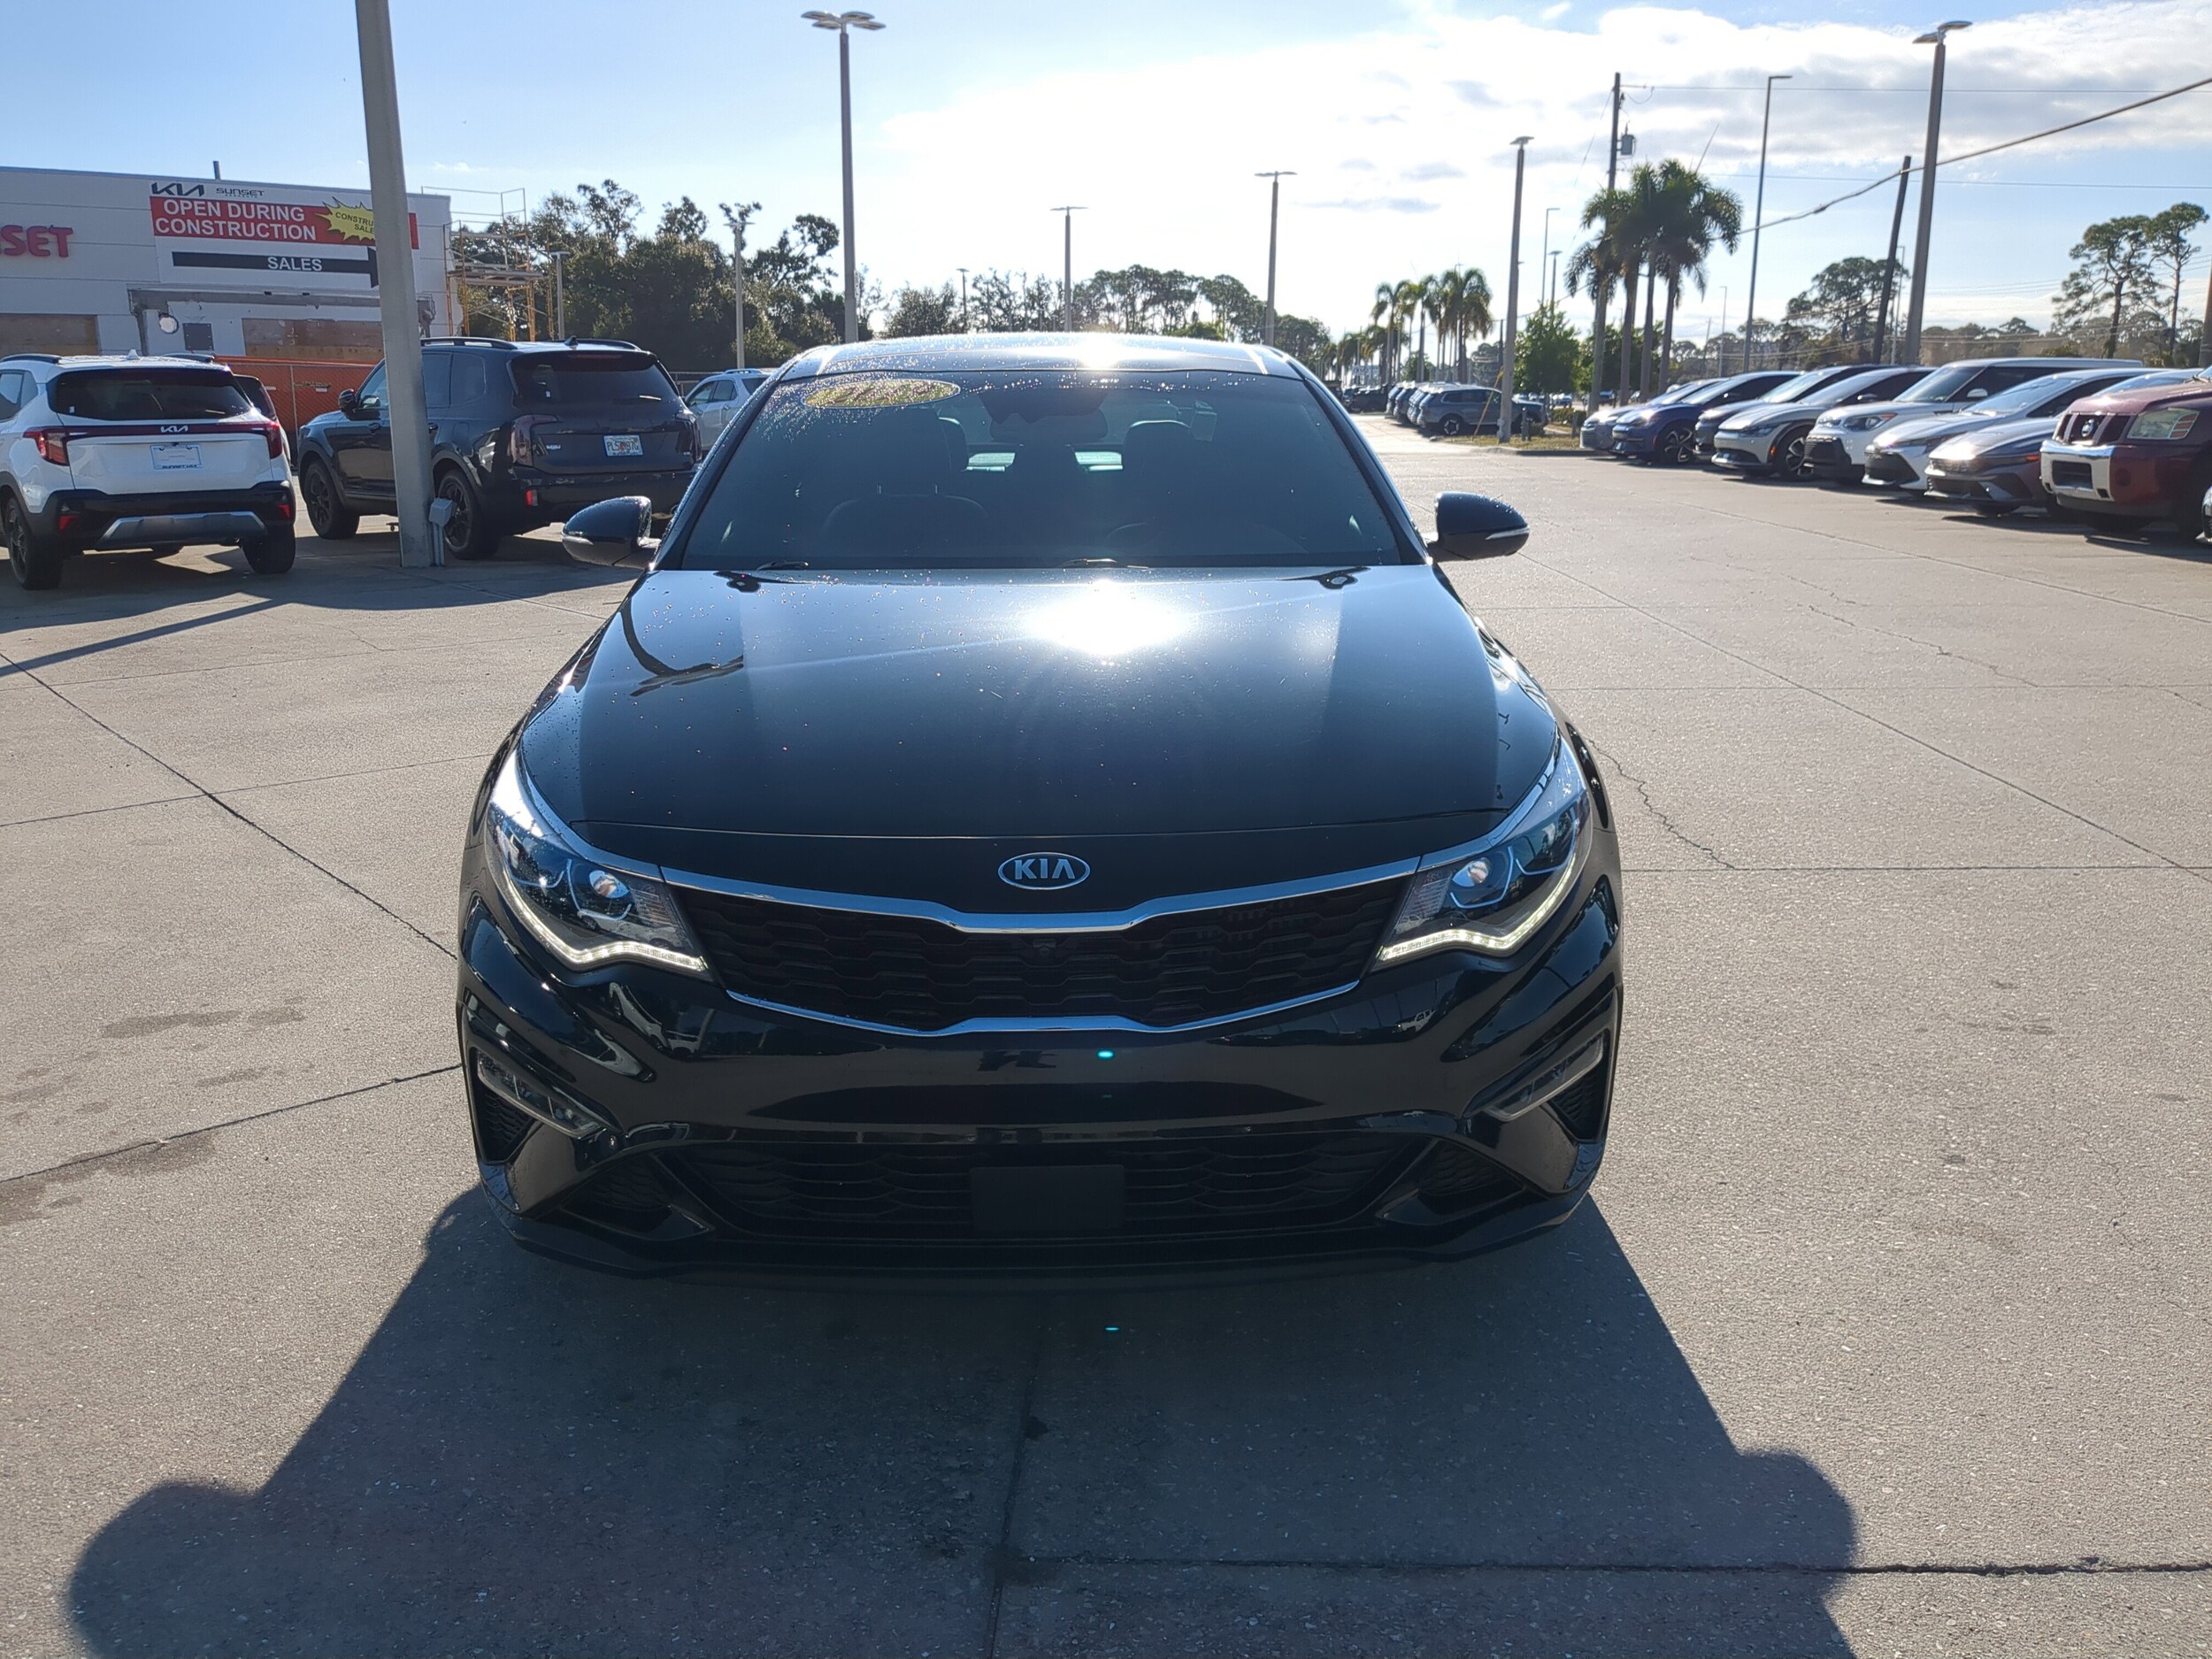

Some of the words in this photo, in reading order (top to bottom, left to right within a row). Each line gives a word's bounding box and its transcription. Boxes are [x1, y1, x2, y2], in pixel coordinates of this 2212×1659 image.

[164, 199, 221, 217] OPEN
[227, 203, 305, 222] DURING
[155, 218, 316, 241] CONSTRUCTION
[267, 257, 322, 272] SALES
[1014, 858, 1076, 879] KIA
